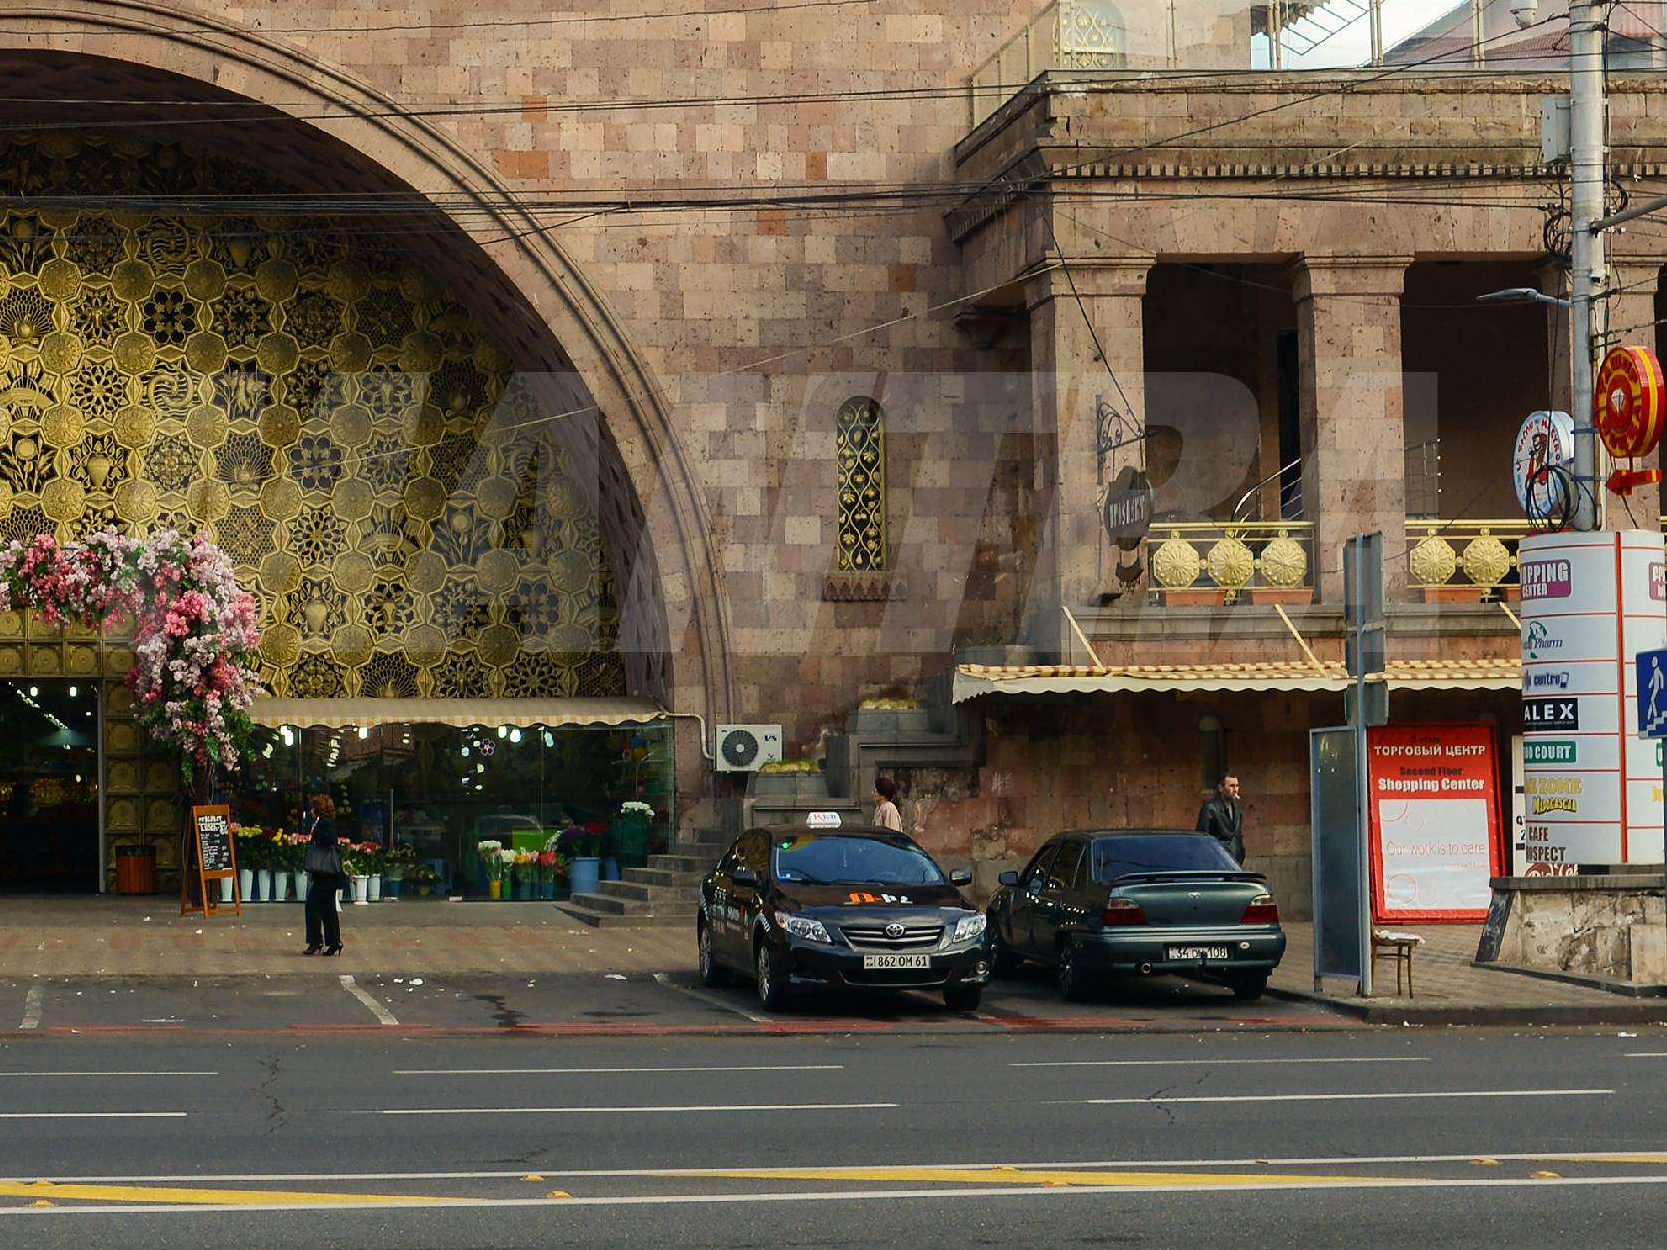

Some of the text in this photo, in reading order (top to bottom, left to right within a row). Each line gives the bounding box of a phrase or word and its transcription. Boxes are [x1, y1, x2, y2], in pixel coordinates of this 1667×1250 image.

[1520, 562, 1569, 584] OPPING
[1374, 743, 1486, 758] ТОРГОВЫЙ ЦЕНТР
[1535, 745, 1572, 760] COURT
[1378, 777, 1485, 793] Shopping Center
[1411, 841, 1437, 856] work
[1462, 843, 1486, 856] care
[1526, 846, 1566, 862] OSPECT
[877, 956, 896, 968] 862
[915, 956, 927, 968] 61
